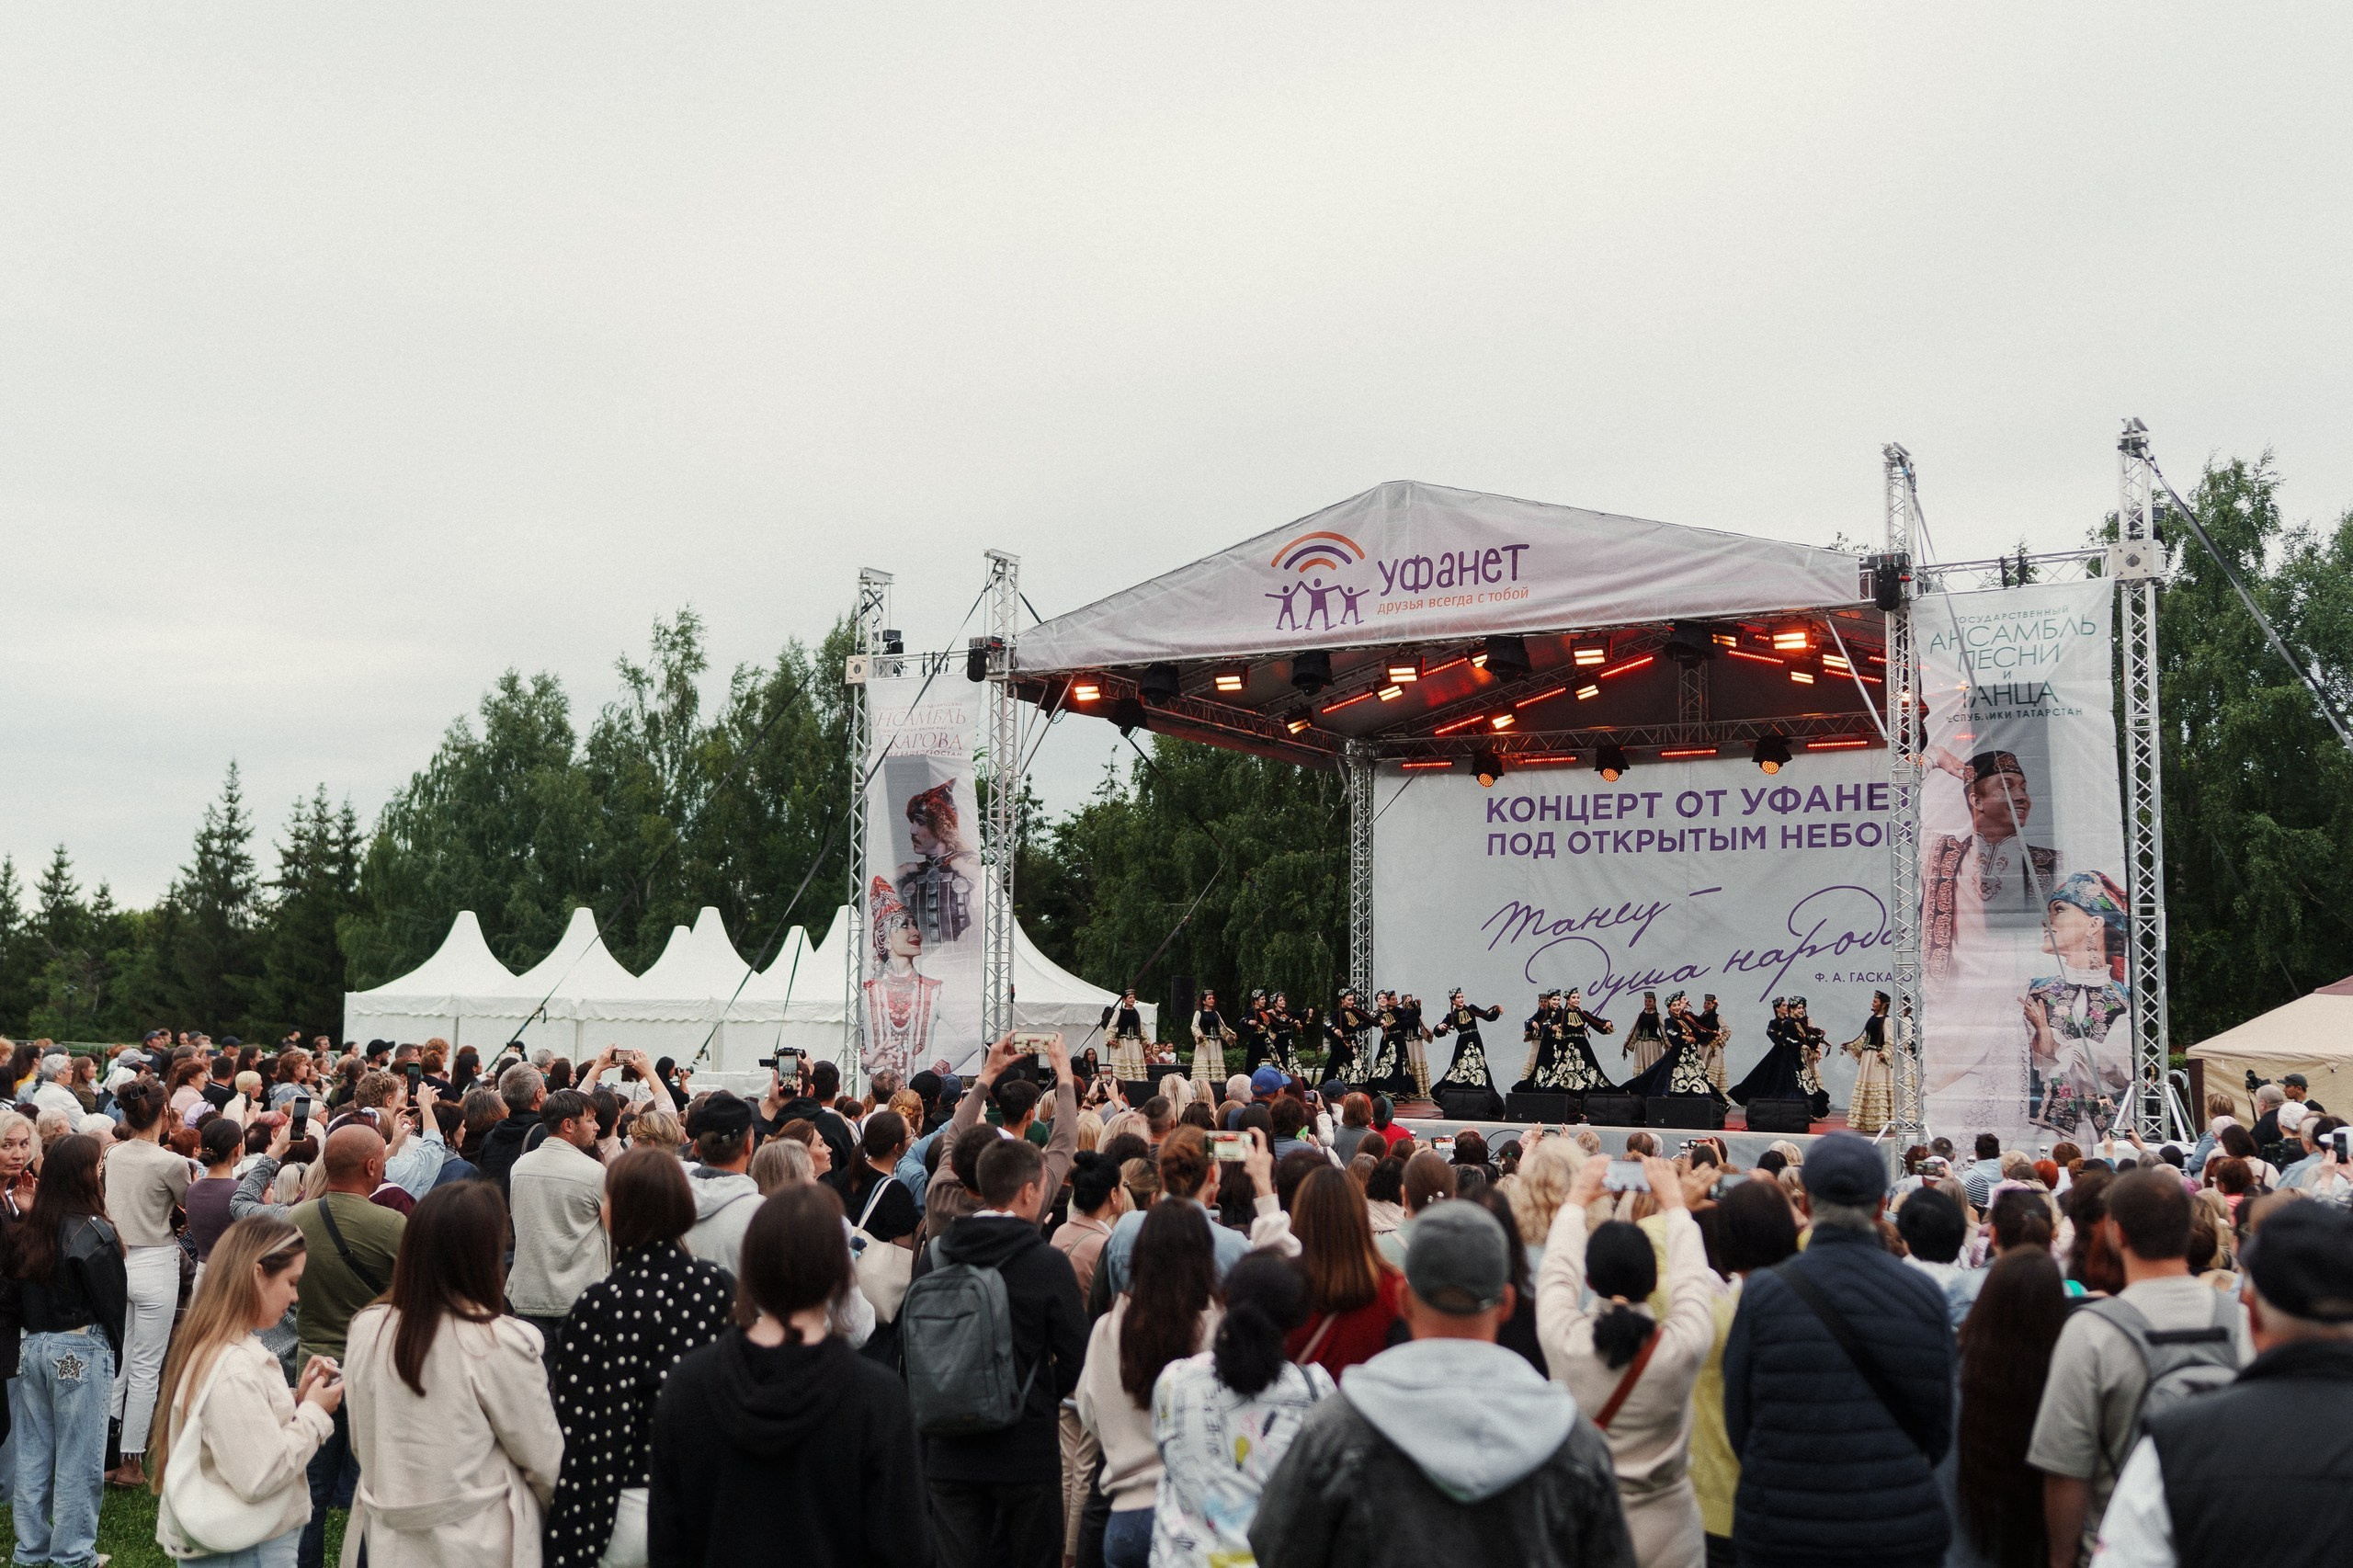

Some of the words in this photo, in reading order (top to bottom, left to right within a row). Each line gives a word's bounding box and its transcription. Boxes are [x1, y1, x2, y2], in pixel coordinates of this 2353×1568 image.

[1377, 598, 1425, 616] друзья
[1428, 594, 1474, 608] всегда
[1477, 593, 1485, 604] с
[1489, 586, 1529, 603] тобой
[1930, 614, 2097, 654] АНСАМБЛЬ
[1958, 642, 2060, 673] ПЕСНИ
[876, 708, 966, 727] НСАМБЛЬ
[2016, 707, 2083, 720] ТАТАРСТАН
[879, 731, 964, 751] СКАРОВА
[1486, 791, 1663, 825] КОНЦЕРТ
[1676, 790, 1728, 818] ОТ
[1487, 831, 1556, 859] ПОД
[1567, 825, 1767, 855] ОТКРЫТЫМ
[1849, 971, 1913, 983] ГАСКАО
